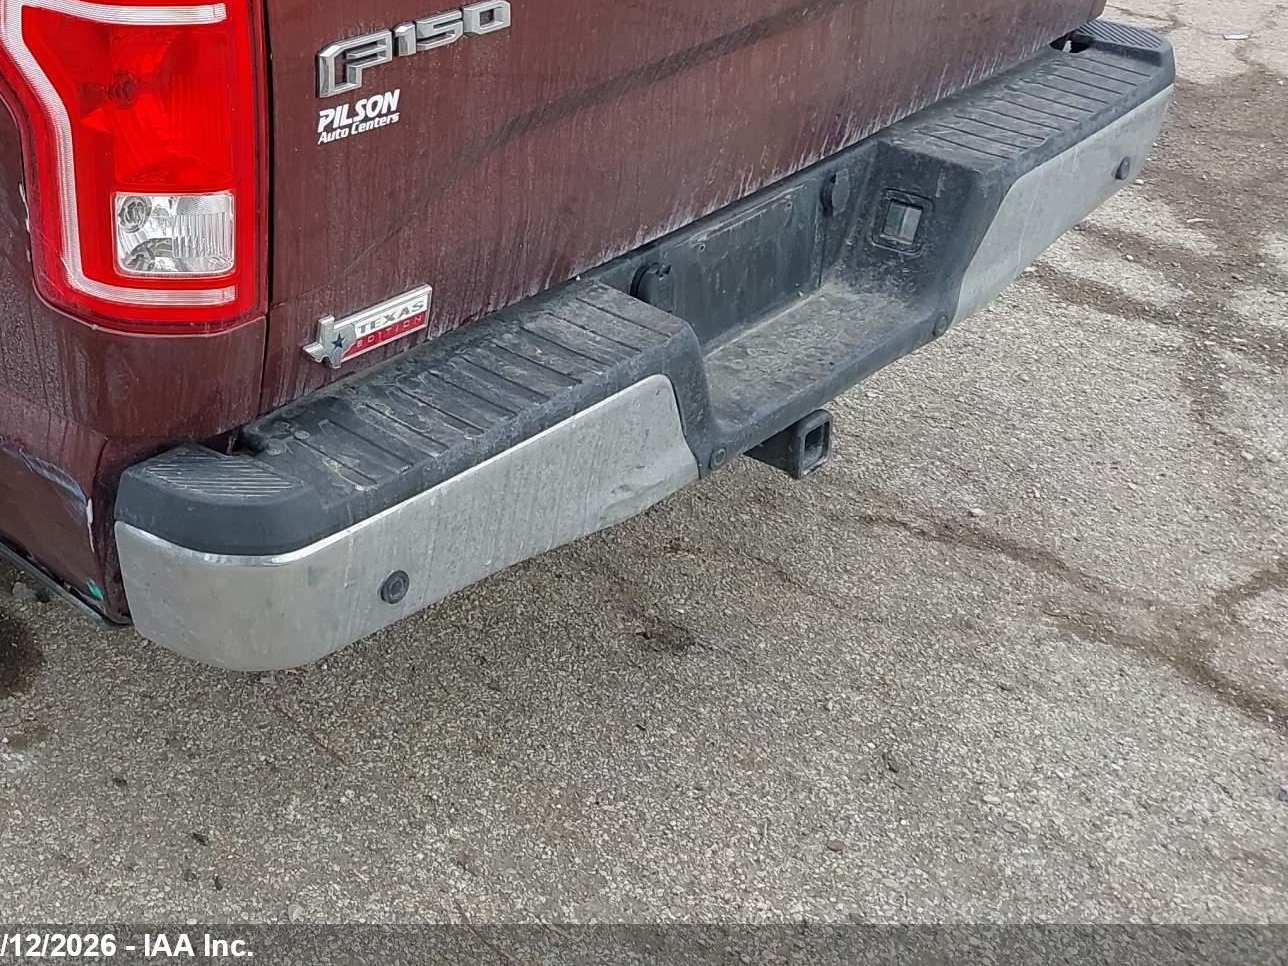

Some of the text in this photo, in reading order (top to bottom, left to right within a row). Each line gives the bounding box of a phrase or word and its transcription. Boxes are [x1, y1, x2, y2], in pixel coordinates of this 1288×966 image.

[317, 88, 401, 133] PILSON
[317, 112, 400, 145] Auto Centers
[356, 300, 424, 334] TEXAS
[357, 315, 423, 348] EDITION
